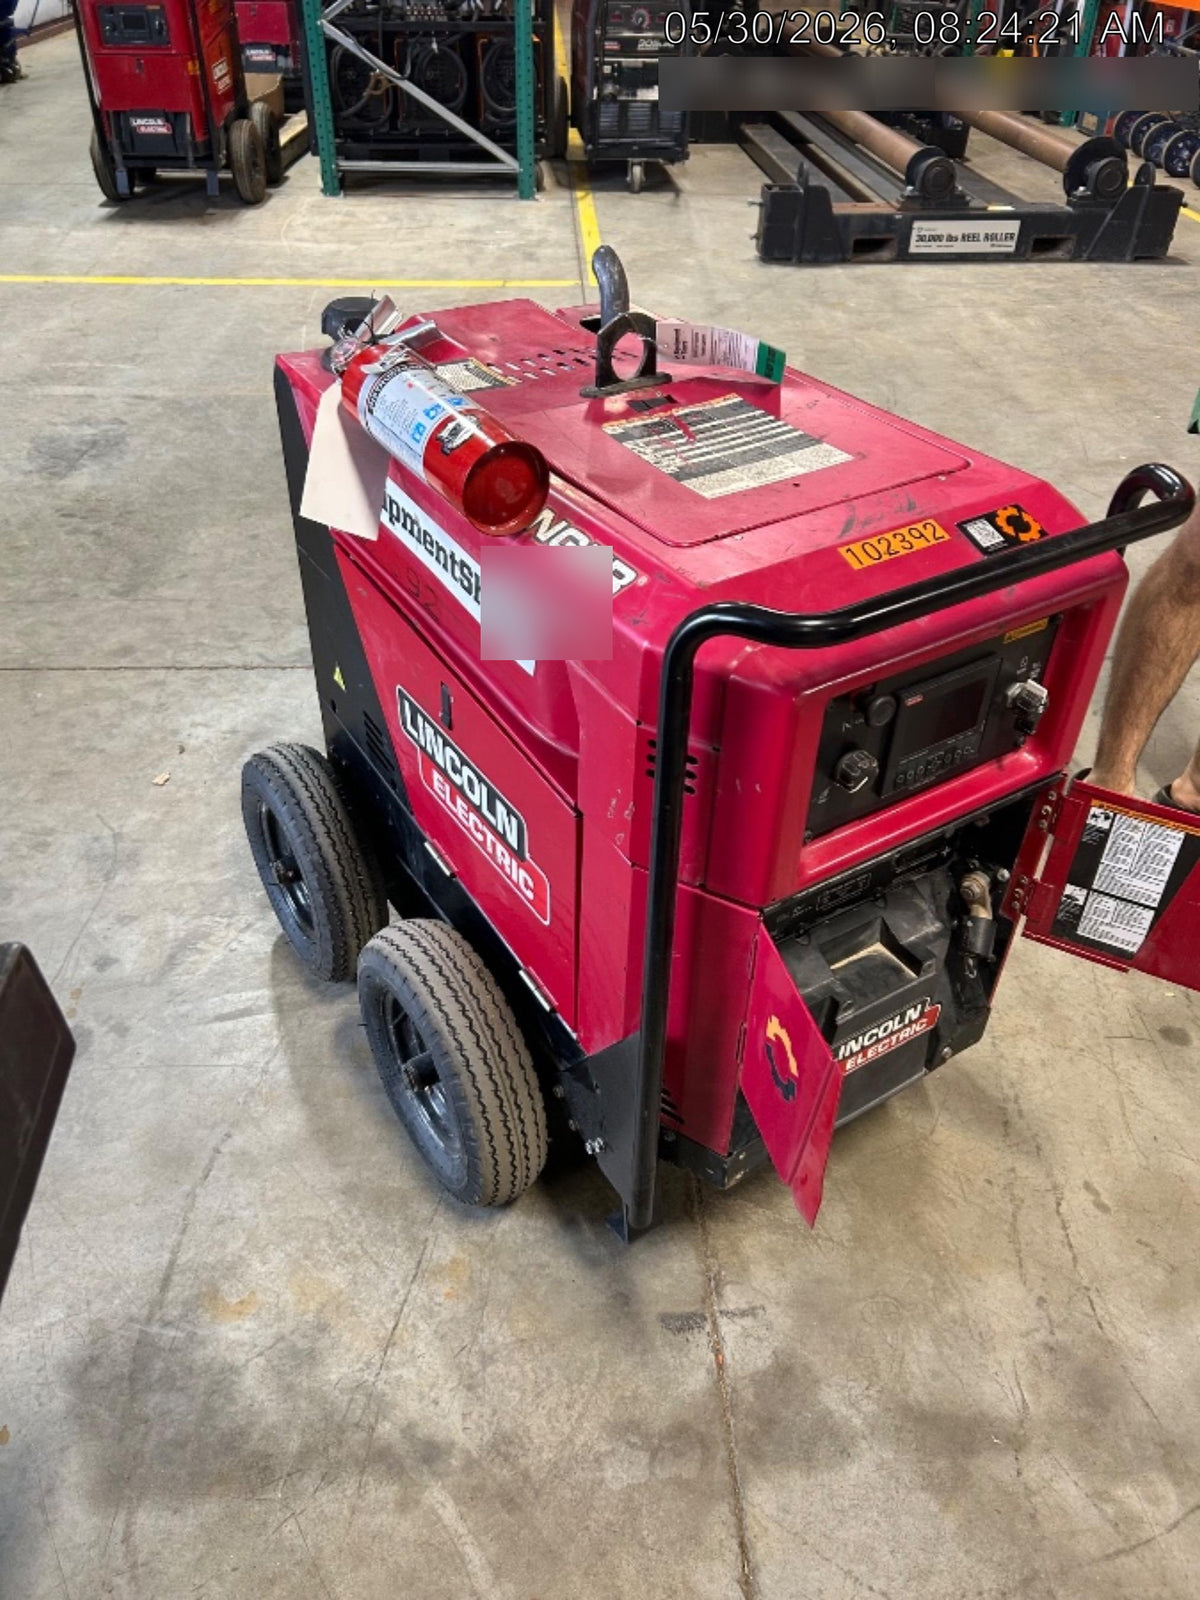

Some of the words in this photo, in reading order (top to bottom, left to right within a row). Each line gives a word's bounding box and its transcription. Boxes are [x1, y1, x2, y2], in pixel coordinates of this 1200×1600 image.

[915, 233, 945, 243] 30,000
[946, 232, 959, 243] lbs
[960, 232, 981, 242] REEL
[983, 231, 1016, 242] ROLLER
[845, 520, 945, 566] 102392
[403, 699, 519, 851] LINCOLN
[432, 768, 535, 900] ELECTRIC
[833, 1003, 922, 1062] INCOLN
[845, 1018, 929, 1071] ELECTRIC
